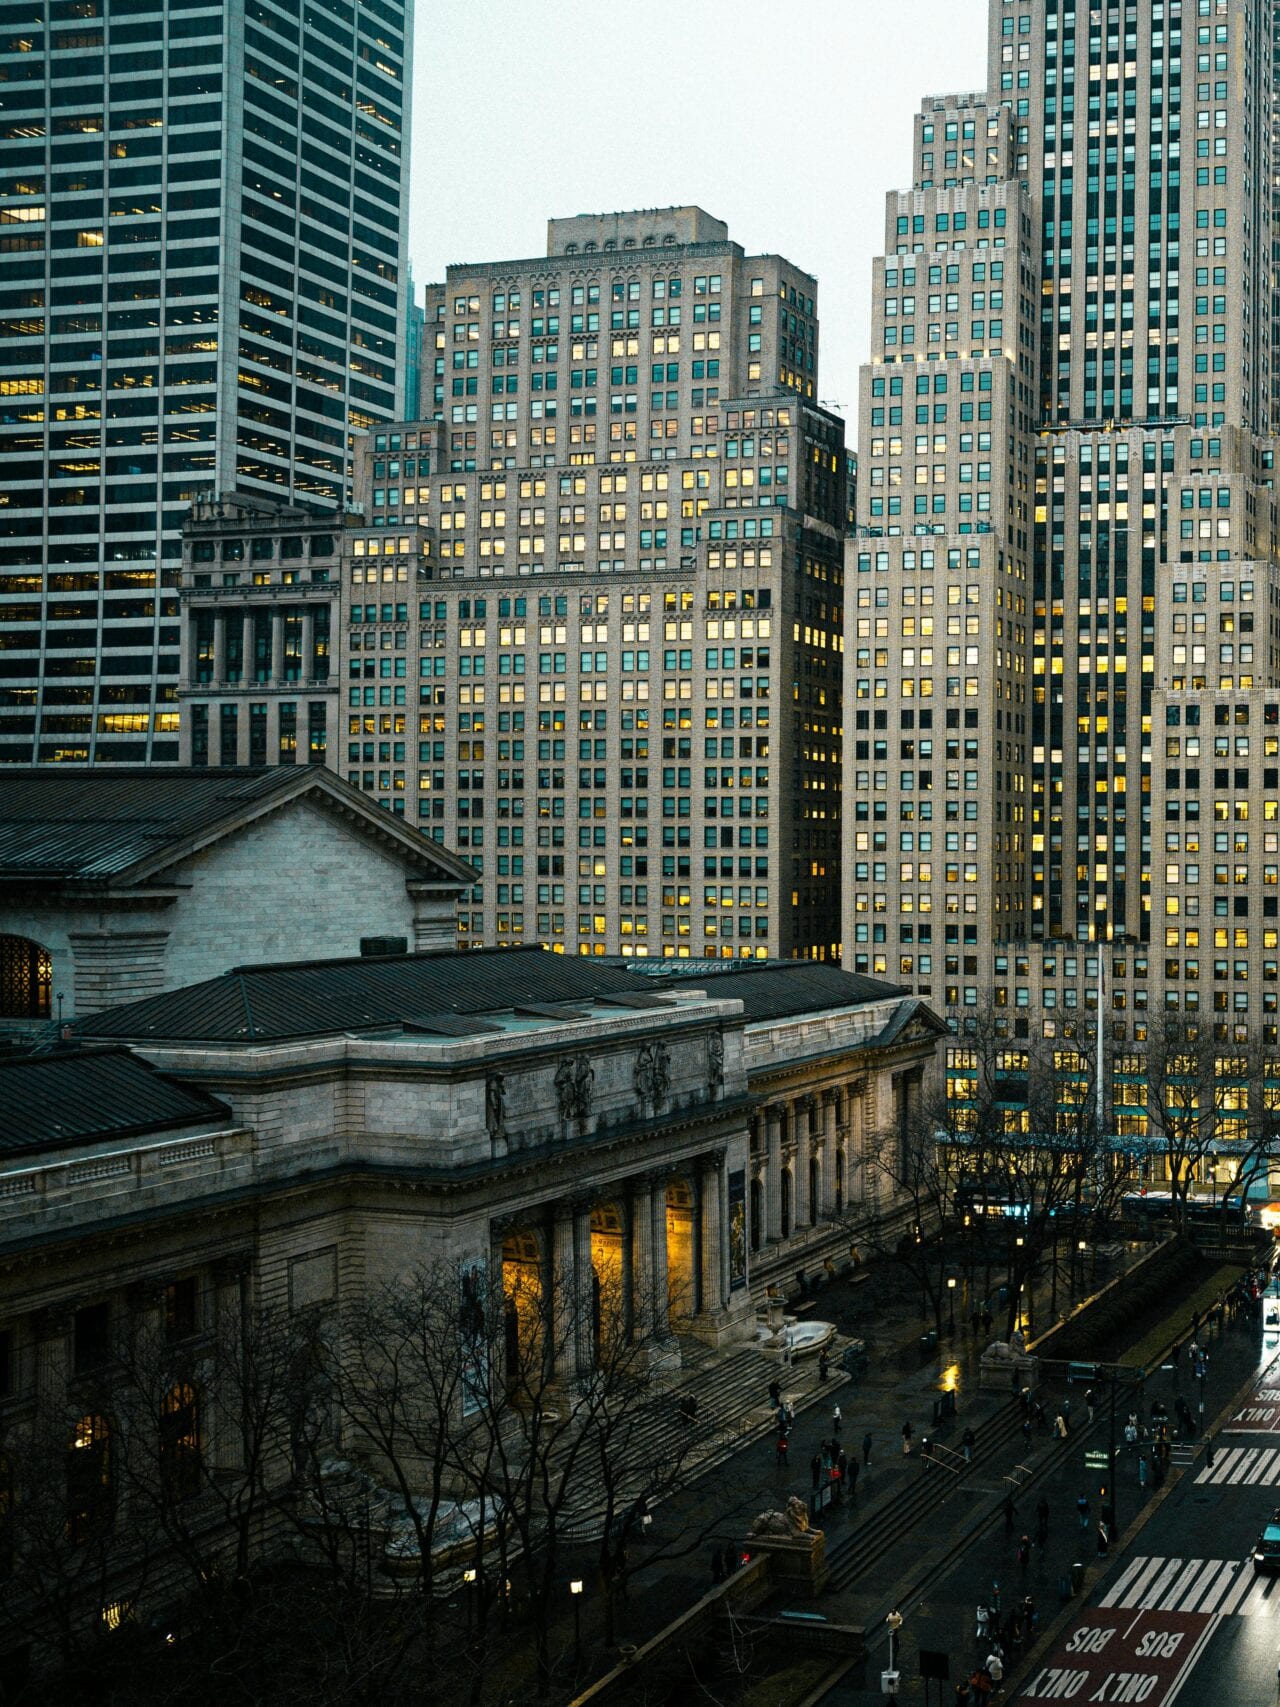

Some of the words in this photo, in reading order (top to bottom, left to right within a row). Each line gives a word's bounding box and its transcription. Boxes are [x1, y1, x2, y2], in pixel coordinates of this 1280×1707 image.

[1232, 1408, 1276, 1422] ONLY
[1066, 1627, 1117, 1653] BUS
[1135, 1631, 1185, 1658] BUS
[1020, 1668, 1090, 1699] ONLY
[1088, 1672, 1159, 1703] ONLY
